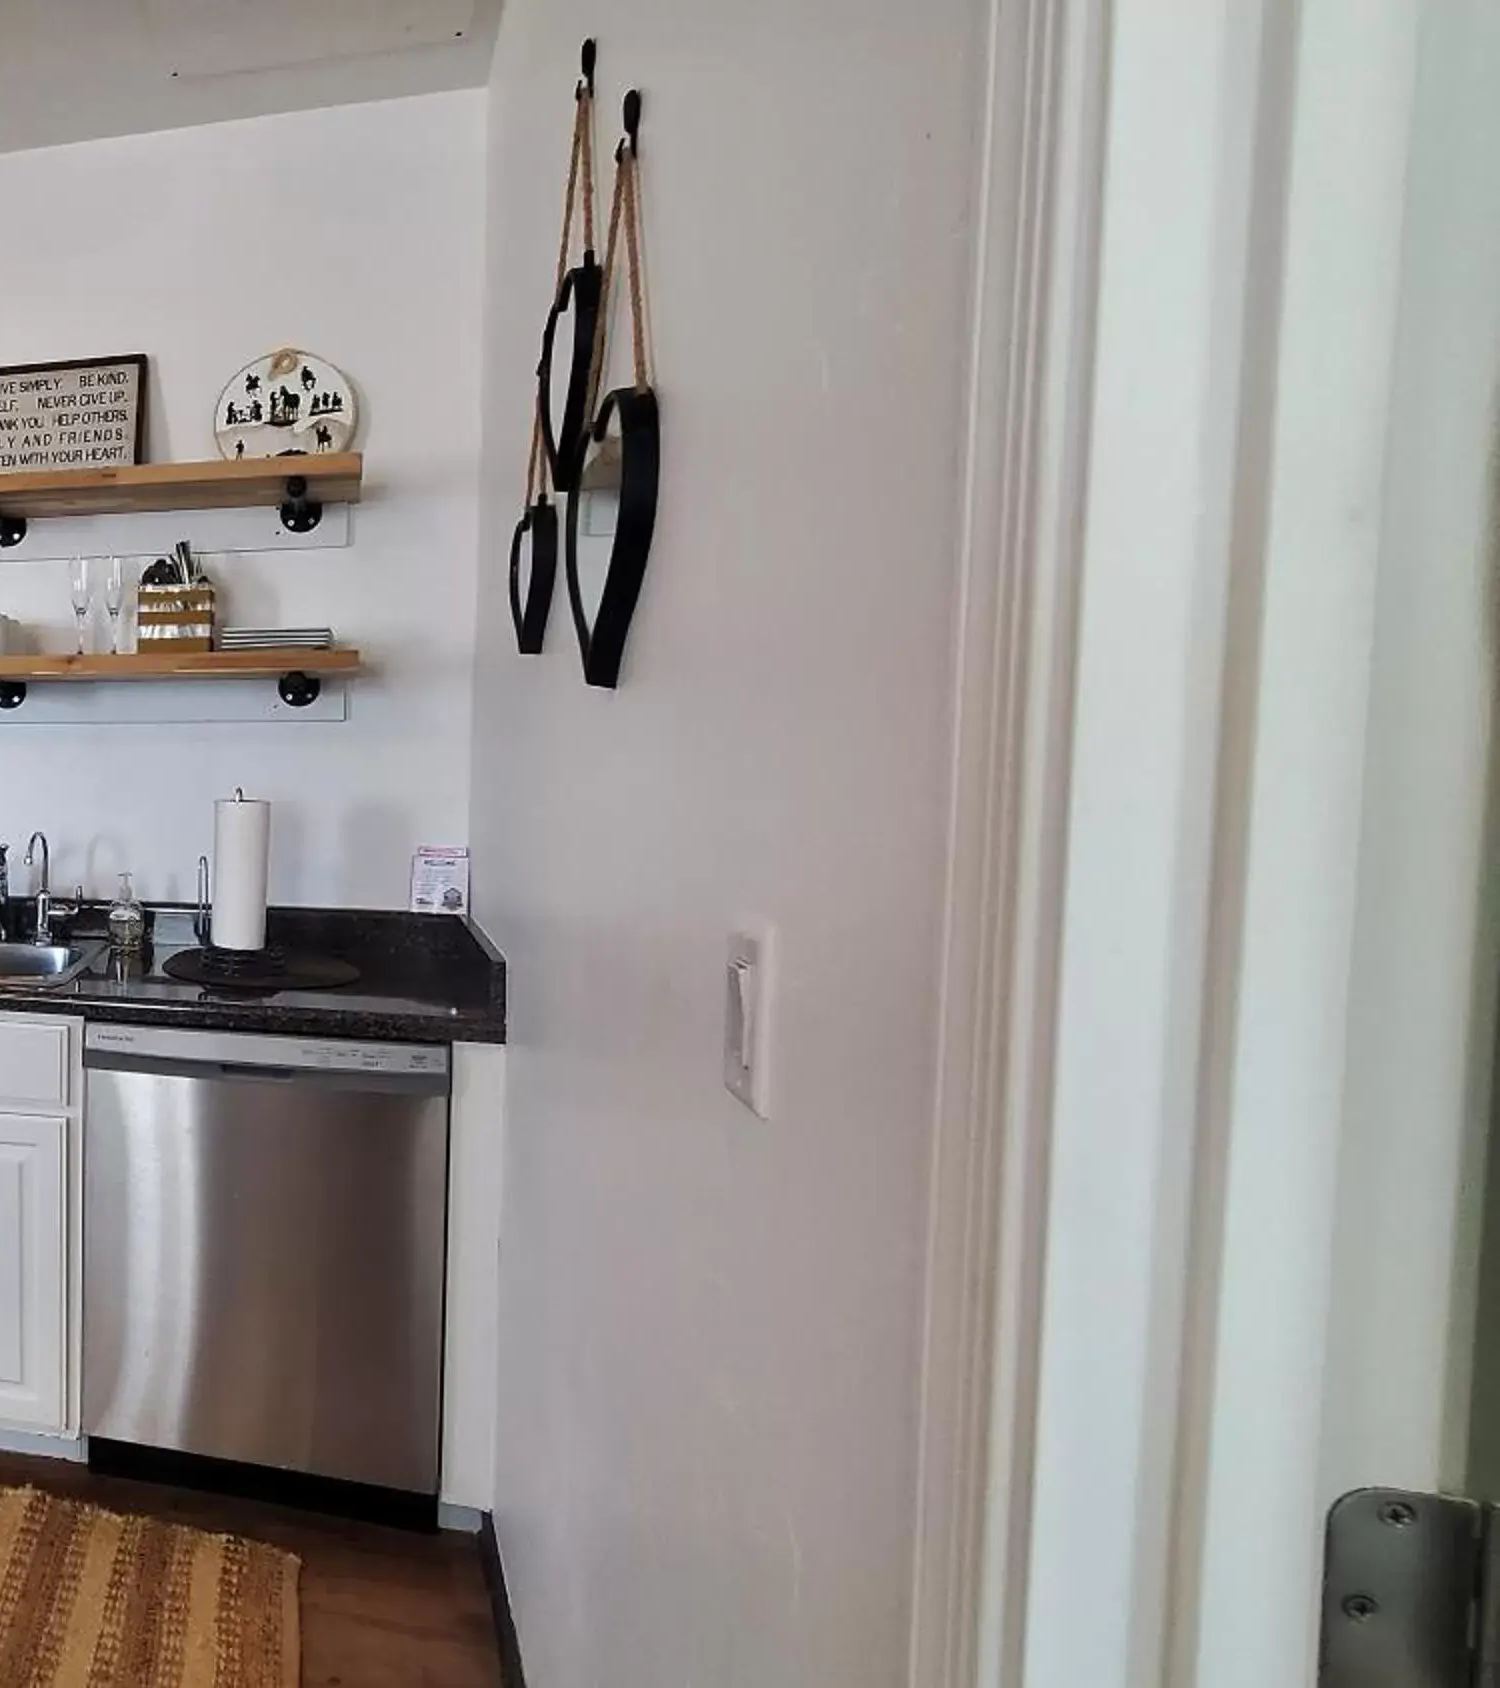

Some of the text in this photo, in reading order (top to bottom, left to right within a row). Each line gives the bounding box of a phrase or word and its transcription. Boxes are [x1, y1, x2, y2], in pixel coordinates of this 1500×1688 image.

[79, 375, 95, 388] BE
[37, 394, 77, 409] NEVER
[80, 391, 107, 406] GIVE
[52, 413, 80, 428] HELP
[22, 433, 53, 448] AND
[20, 452, 49, 465] WITH
[51, 449, 82, 463] YOUR
